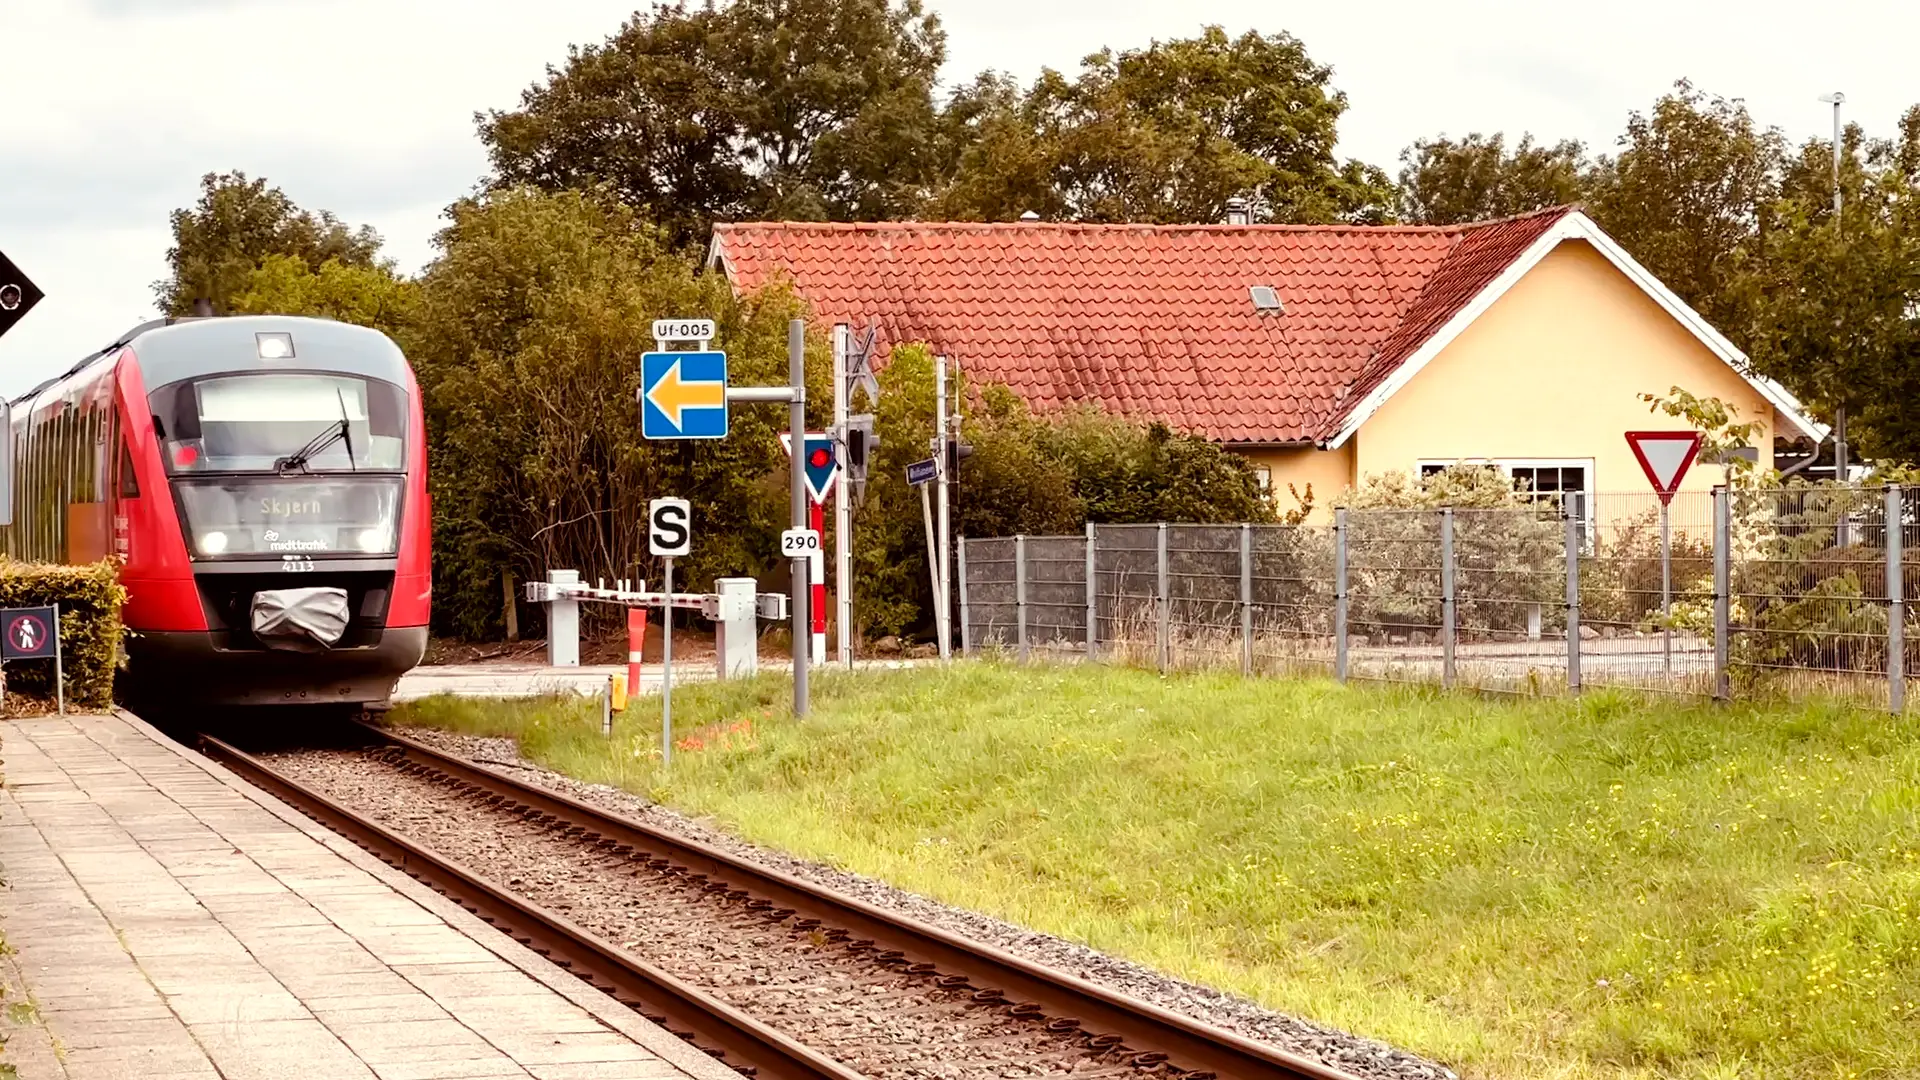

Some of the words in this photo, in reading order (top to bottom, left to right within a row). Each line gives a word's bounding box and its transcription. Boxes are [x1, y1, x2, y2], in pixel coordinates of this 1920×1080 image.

[658, 324, 709, 336] Uf-005
[261, 497, 320, 517] Skjern
[652, 505, 688, 550] S
[785, 536, 818, 550] 290
[282, 561, 314, 572] 4113
